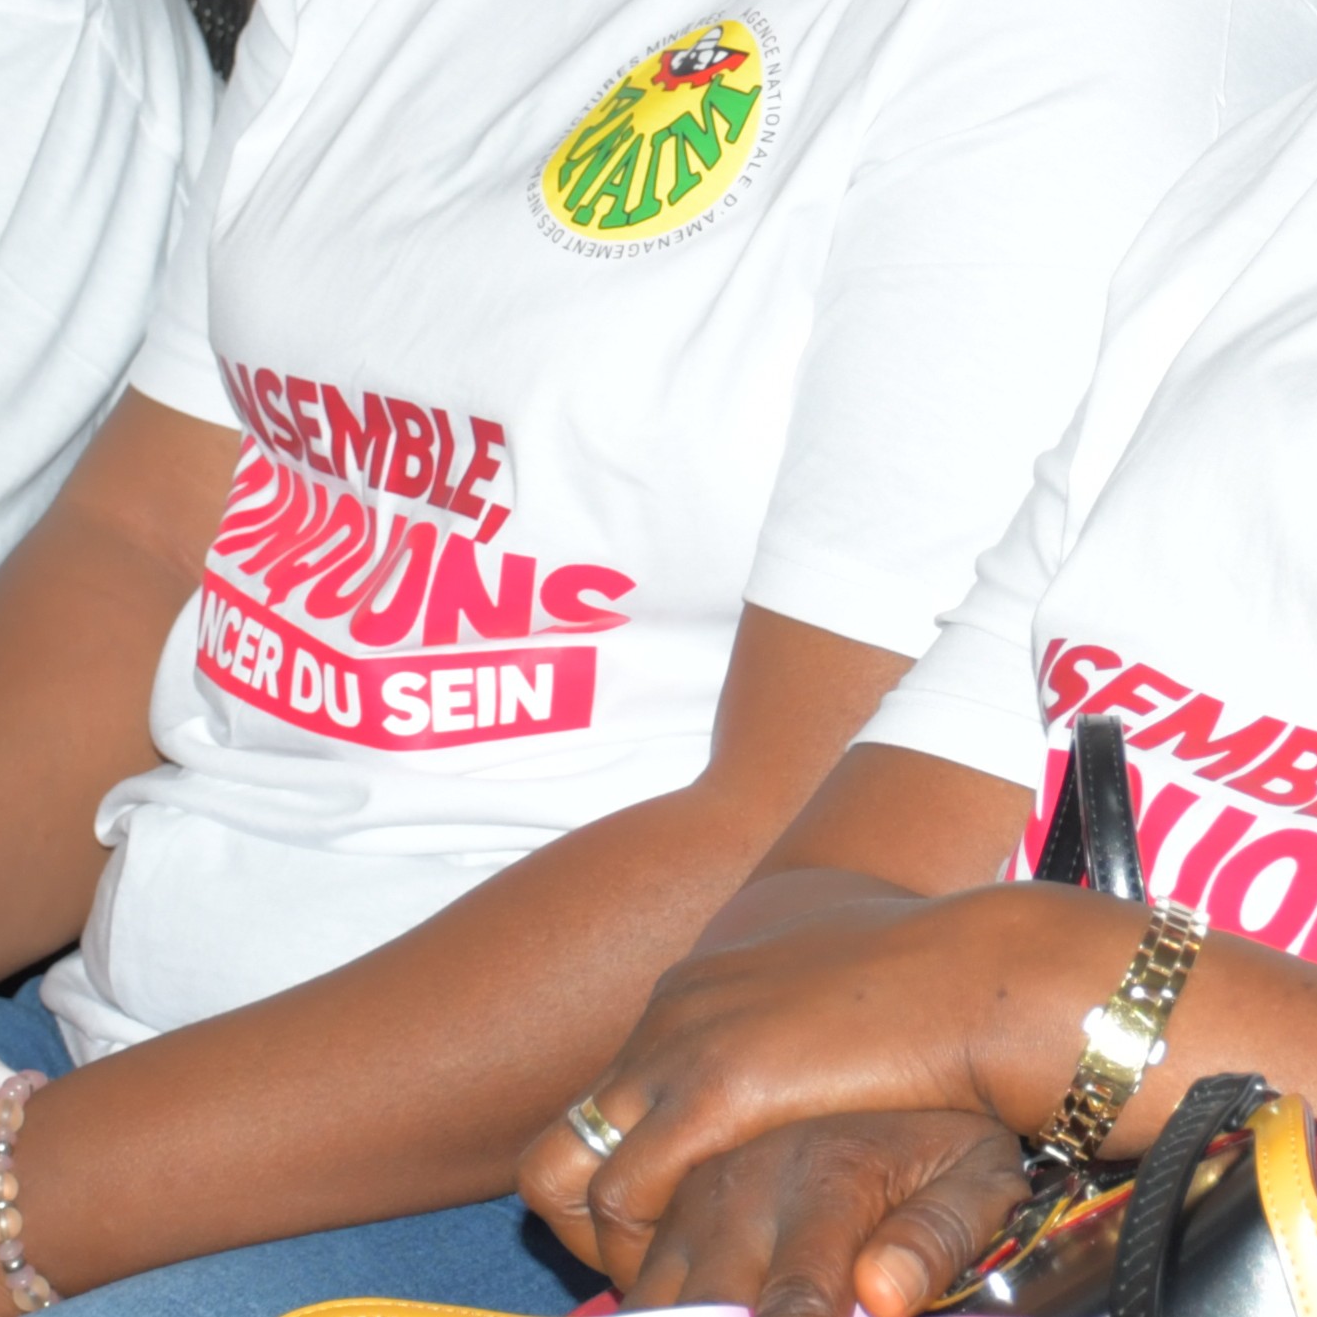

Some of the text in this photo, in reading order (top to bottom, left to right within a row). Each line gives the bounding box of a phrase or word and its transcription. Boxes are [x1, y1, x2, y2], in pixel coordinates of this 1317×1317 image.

[741, 7, 781, 59] AGENCE
[738, 62, 782, 189] NATIONALE
[536, 213, 565, 245] DES
[290, 648, 361, 728] DU
[381, 663, 555, 736] SEIN
